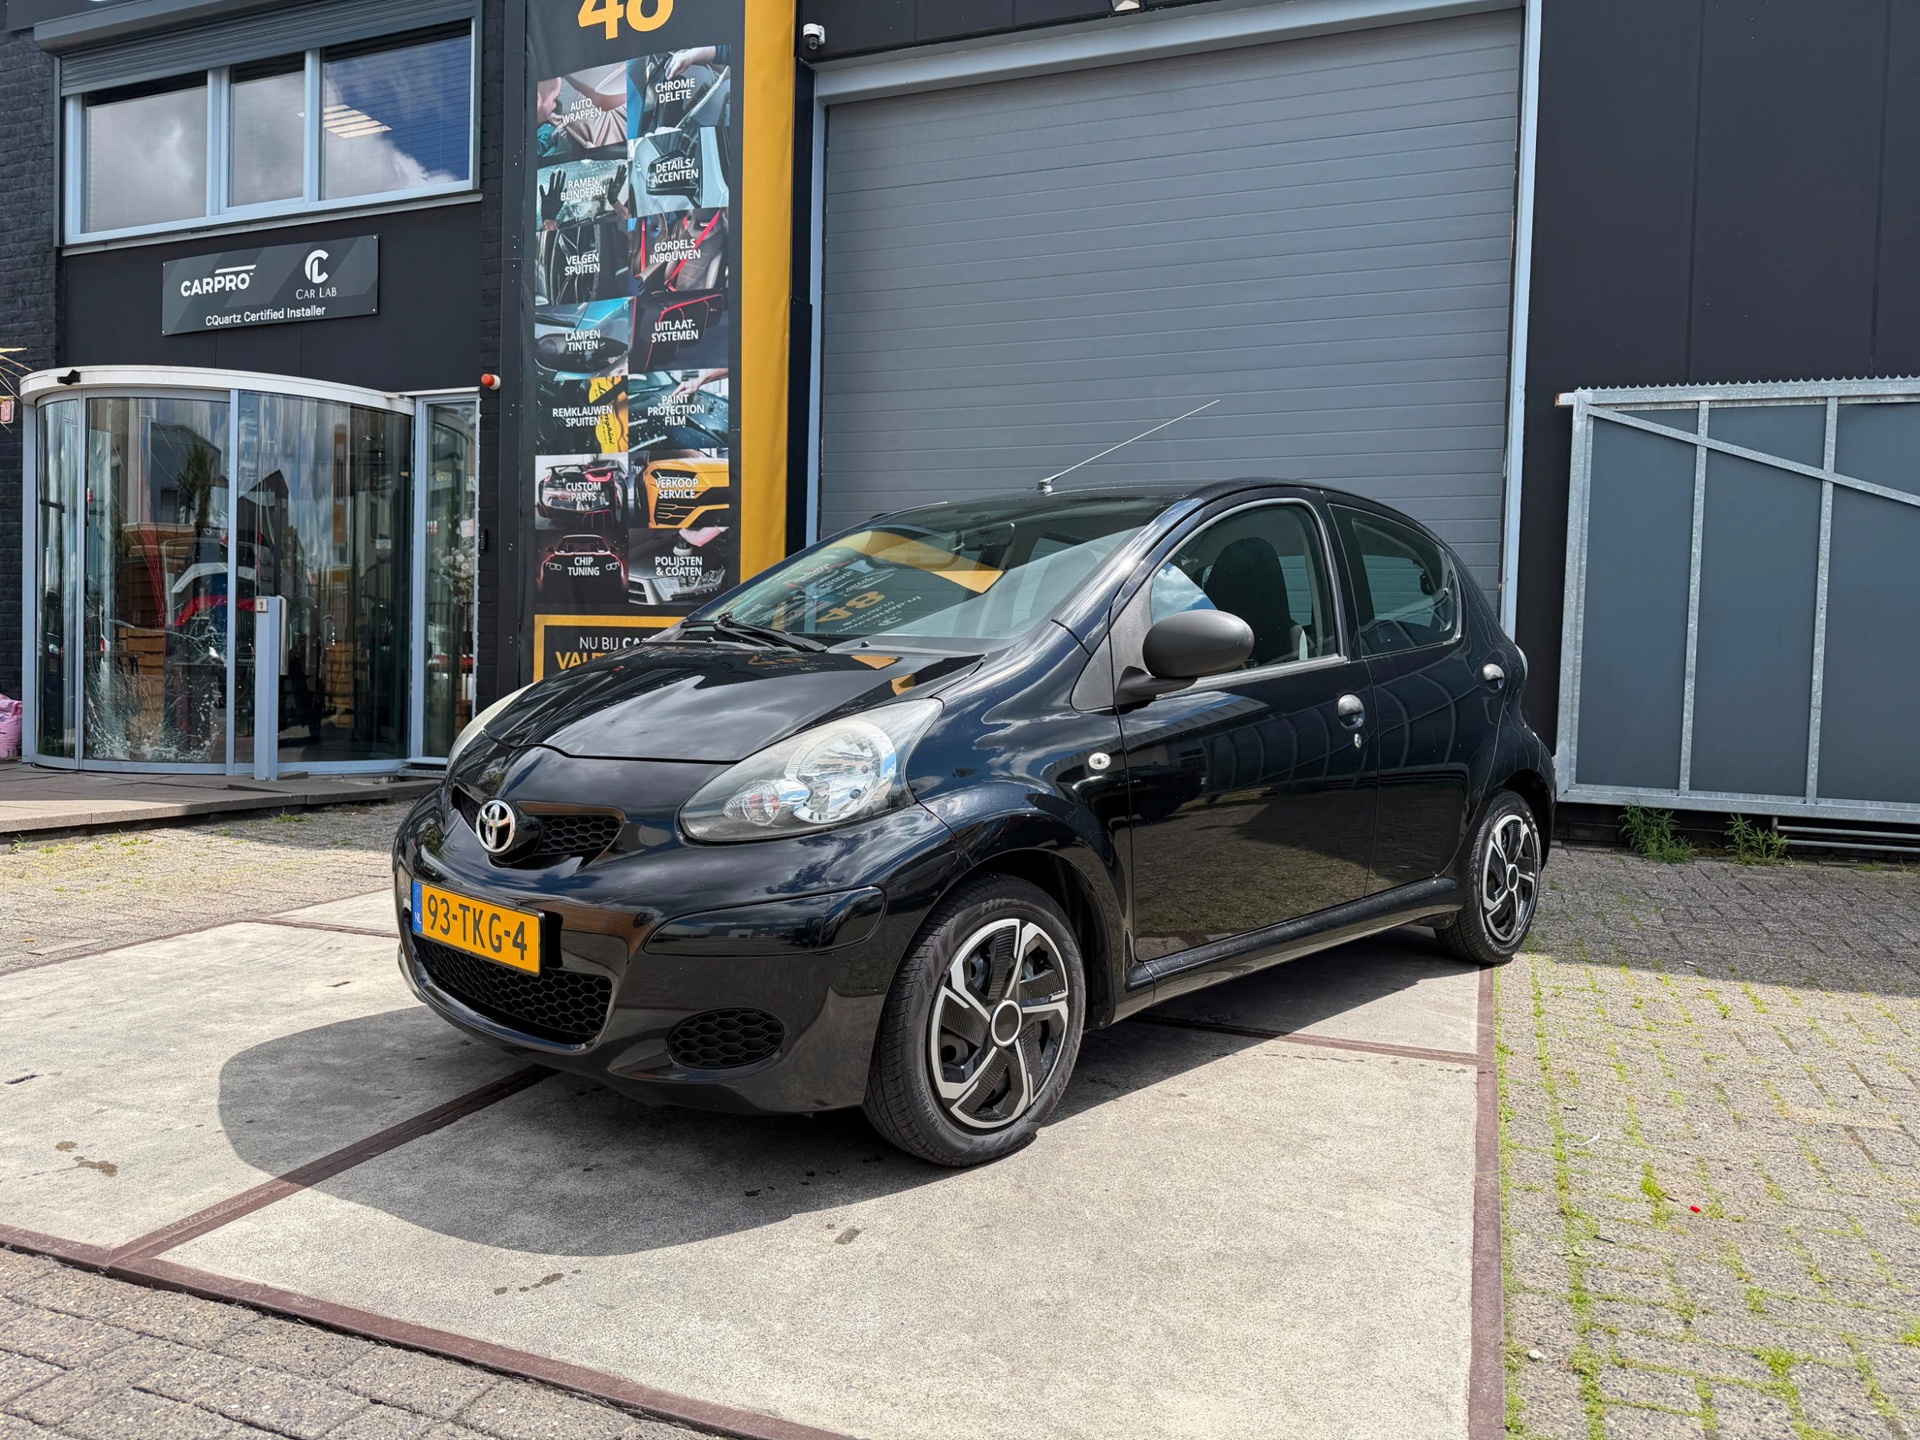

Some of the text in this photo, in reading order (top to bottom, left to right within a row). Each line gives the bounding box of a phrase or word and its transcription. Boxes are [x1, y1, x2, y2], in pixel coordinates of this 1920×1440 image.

[655, 78, 696, 94] CHROME
[659, 90, 691, 103] DELETE
[570, 98, 592, 111] AUTO
[562, 107, 602, 125] WRAPPEN
[656, 158, 695, 174] DETAILS/
[568, 176, 598, 189] RAMEN
[651, 169, 699, 185] ACCENTEN
[560, 185, 606, 201] BLINDEREN
[654, 238, 696, 253] GORDELS
[566, 253, 599, 265] VELGEN
[650, 249, 701, 264] INBOUWEN
[564, 263, 600, 276] SPUITEN
[180, 272, 250, 297] CARPRO
[205, 305, 326, 326] CQuartz Certified Installer
[654, 319, 696, 332] UITLAAT-
[565, 330, 600, 342] LAMPEN
[651, 330, 699, 343] SYSTEMEN
[568, 341, 599, 351] TINTEN
[661, 395, 689, 405] PAINT
[552, 405, 613, 418] REMKLAUWEN
[647, 404, 705, 417] PROTECTION
[565, 417, 600, 428] SPUITEN
[664, 415, 686, 426] FILM
[565, 482, 601, 492] CUSTOM
[655, 478, 699, 489] VERKOOP
[571, 492, 597, 502] PARTS
[658, 489, 695, 499] SERVICE
[574, 556, 594, 566] CHIP
[655, 556, 703, 568] POLIJSTEN
[567, 566, 600, 576] TUNING
[656, 566, 702, 577] & COATEN
[579, 637, 598, 650] NU
[602, 637, 619, 650] BIJ
[414, 911, 422, 924] NL
[427, 894, 527, 961] 93-TKG-4
